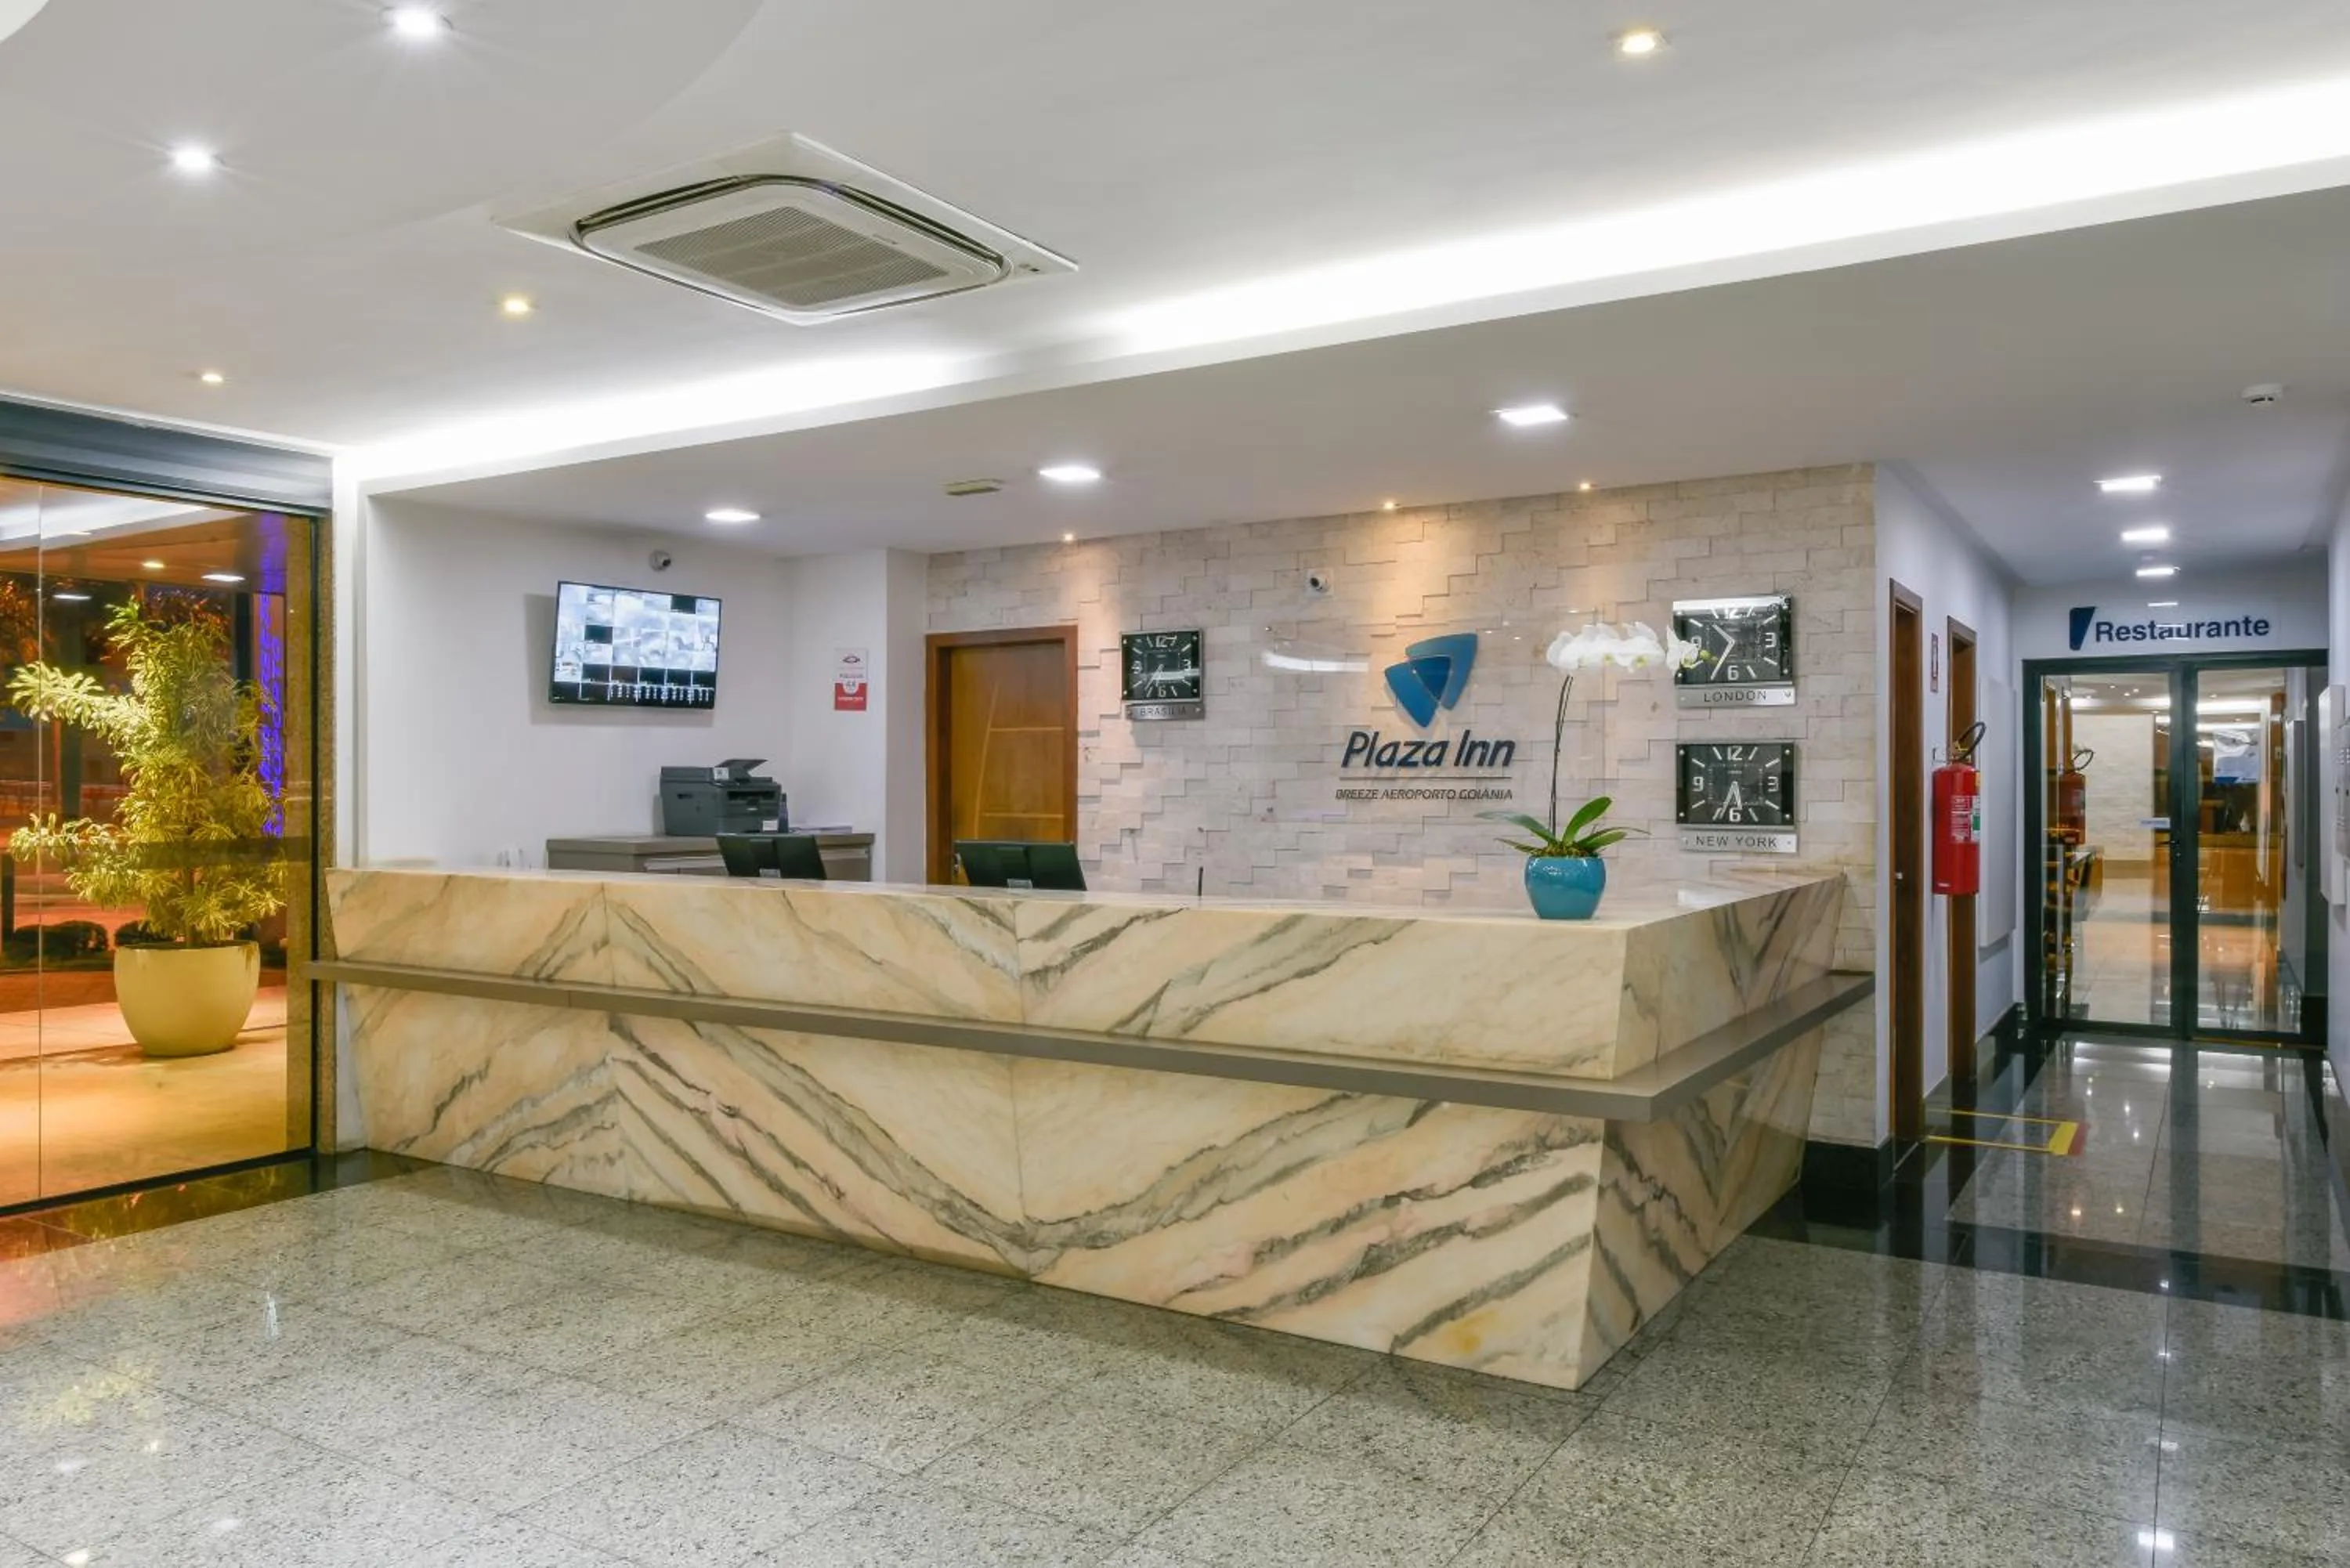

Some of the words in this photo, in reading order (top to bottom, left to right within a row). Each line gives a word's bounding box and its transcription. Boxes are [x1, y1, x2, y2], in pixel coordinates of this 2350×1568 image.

[2095, 616, 2269, 642] Restaurante
[1765, 632, 1777, 649] 3
[1727, 665, 1739, 681] 6
[1159, 686, 1166, 697] 6
[1704, 690, 1766, 703] LONDON
[1341, 731, 1450, 768] Plaza
[1453, 729, 1516, 767] Inn
[1727, 746, 1743, 761] 12
[1692, 776, 1704, 792] 9
[1767, 776, 1779, 792] 3
[1335, 789, 1379, 800] BREEZE
[1381, 789, 1455, 800] AEROPORTO
[1730, 807, 1741, 822] 6
[1696, 835, 1729, 847] NEW
[1735, 836, 1777, 847] YORK
